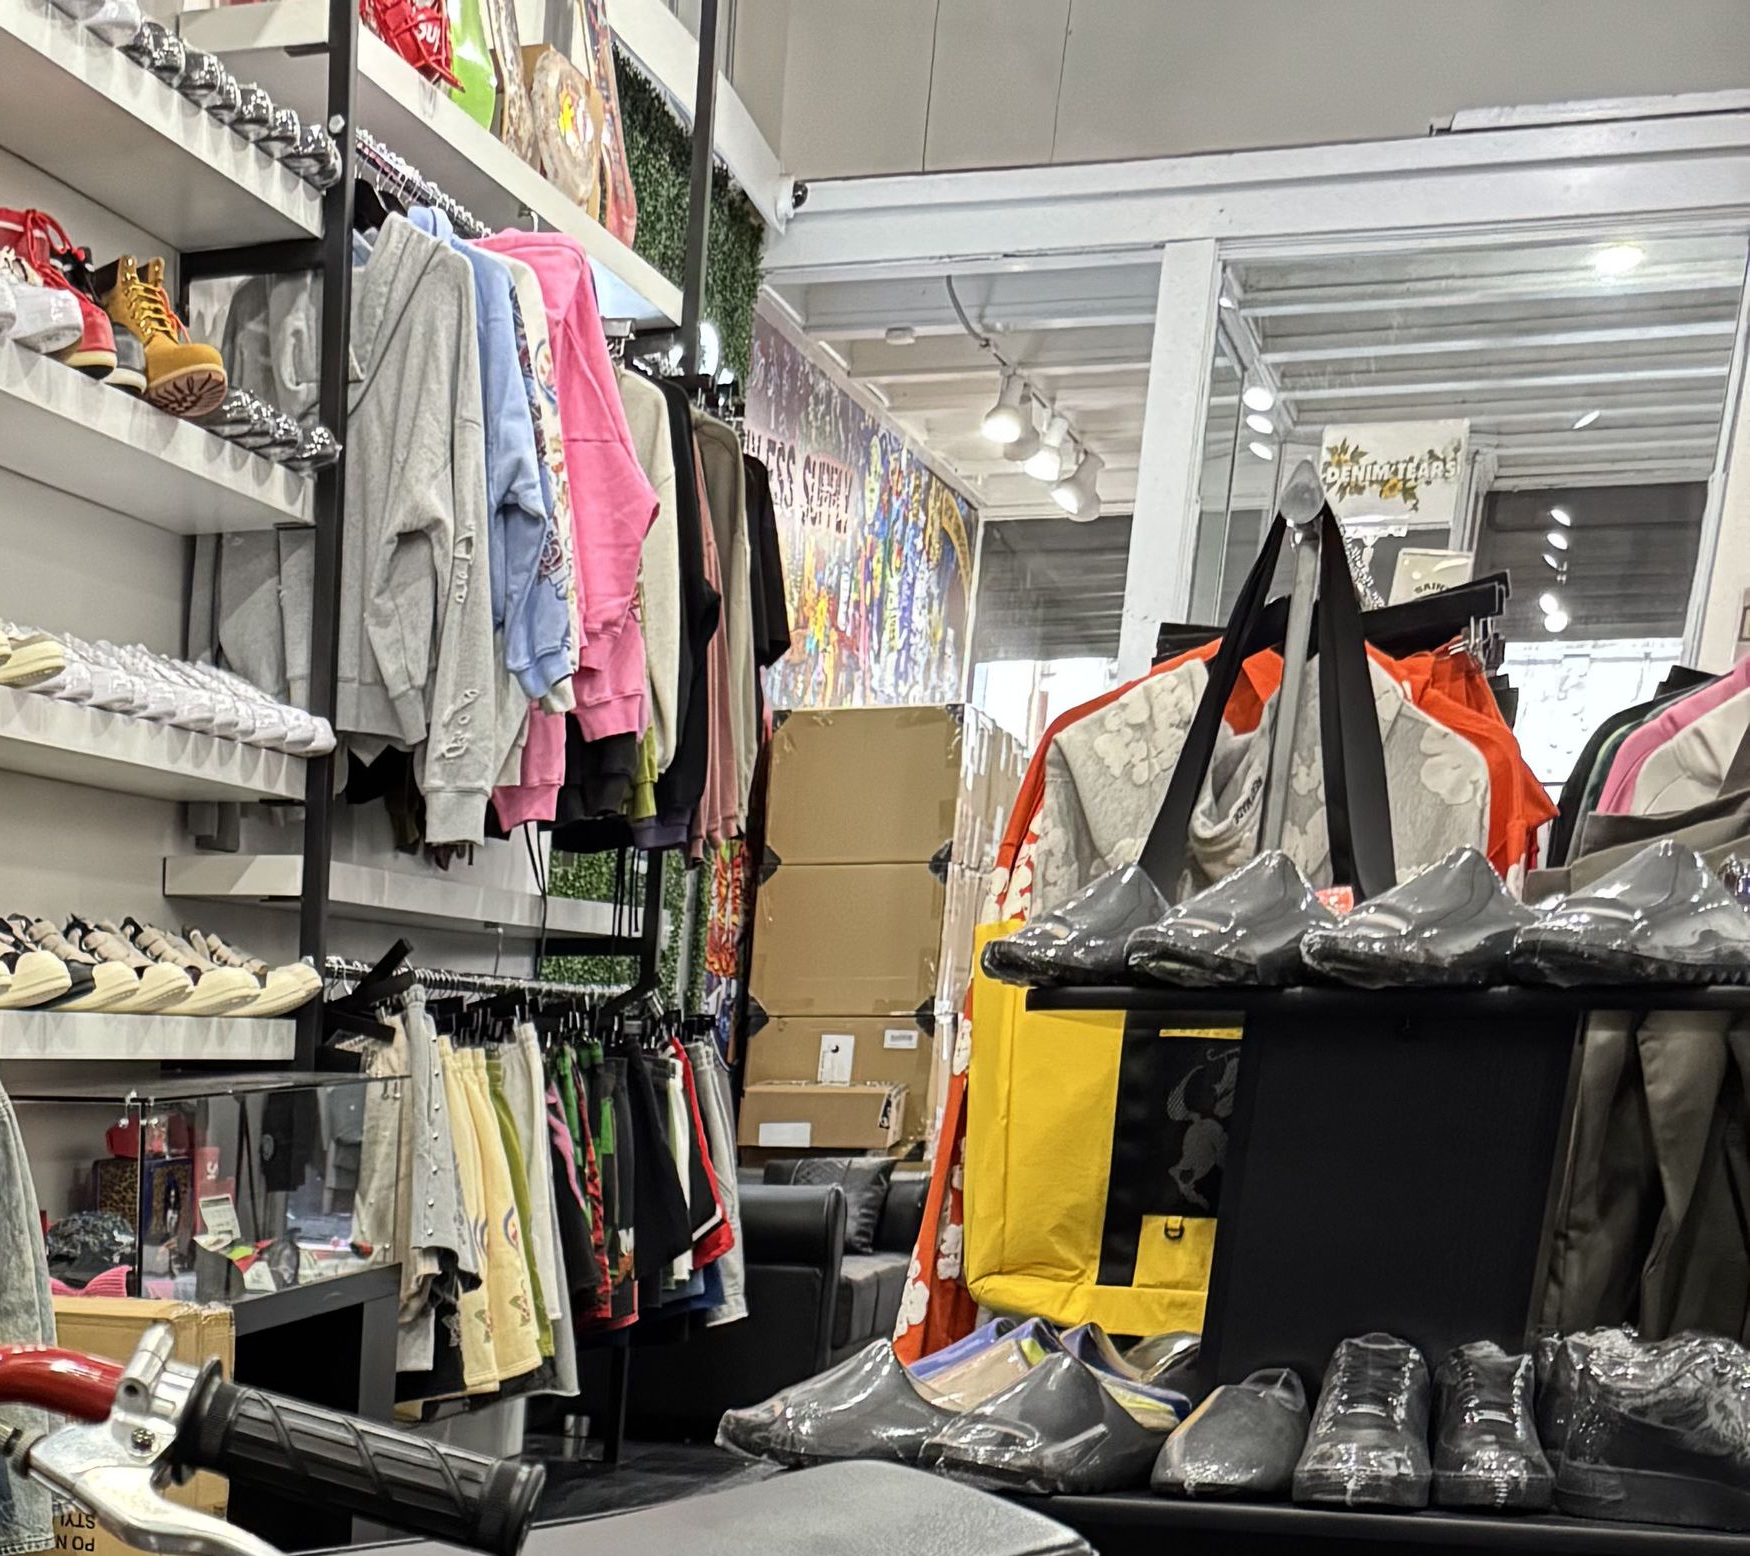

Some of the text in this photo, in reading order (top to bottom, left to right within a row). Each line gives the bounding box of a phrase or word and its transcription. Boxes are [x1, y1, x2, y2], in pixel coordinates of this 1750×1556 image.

[1325, 460, 1456, 483] DENIM TEARS
[71, 1536, 96, 1552] PO
